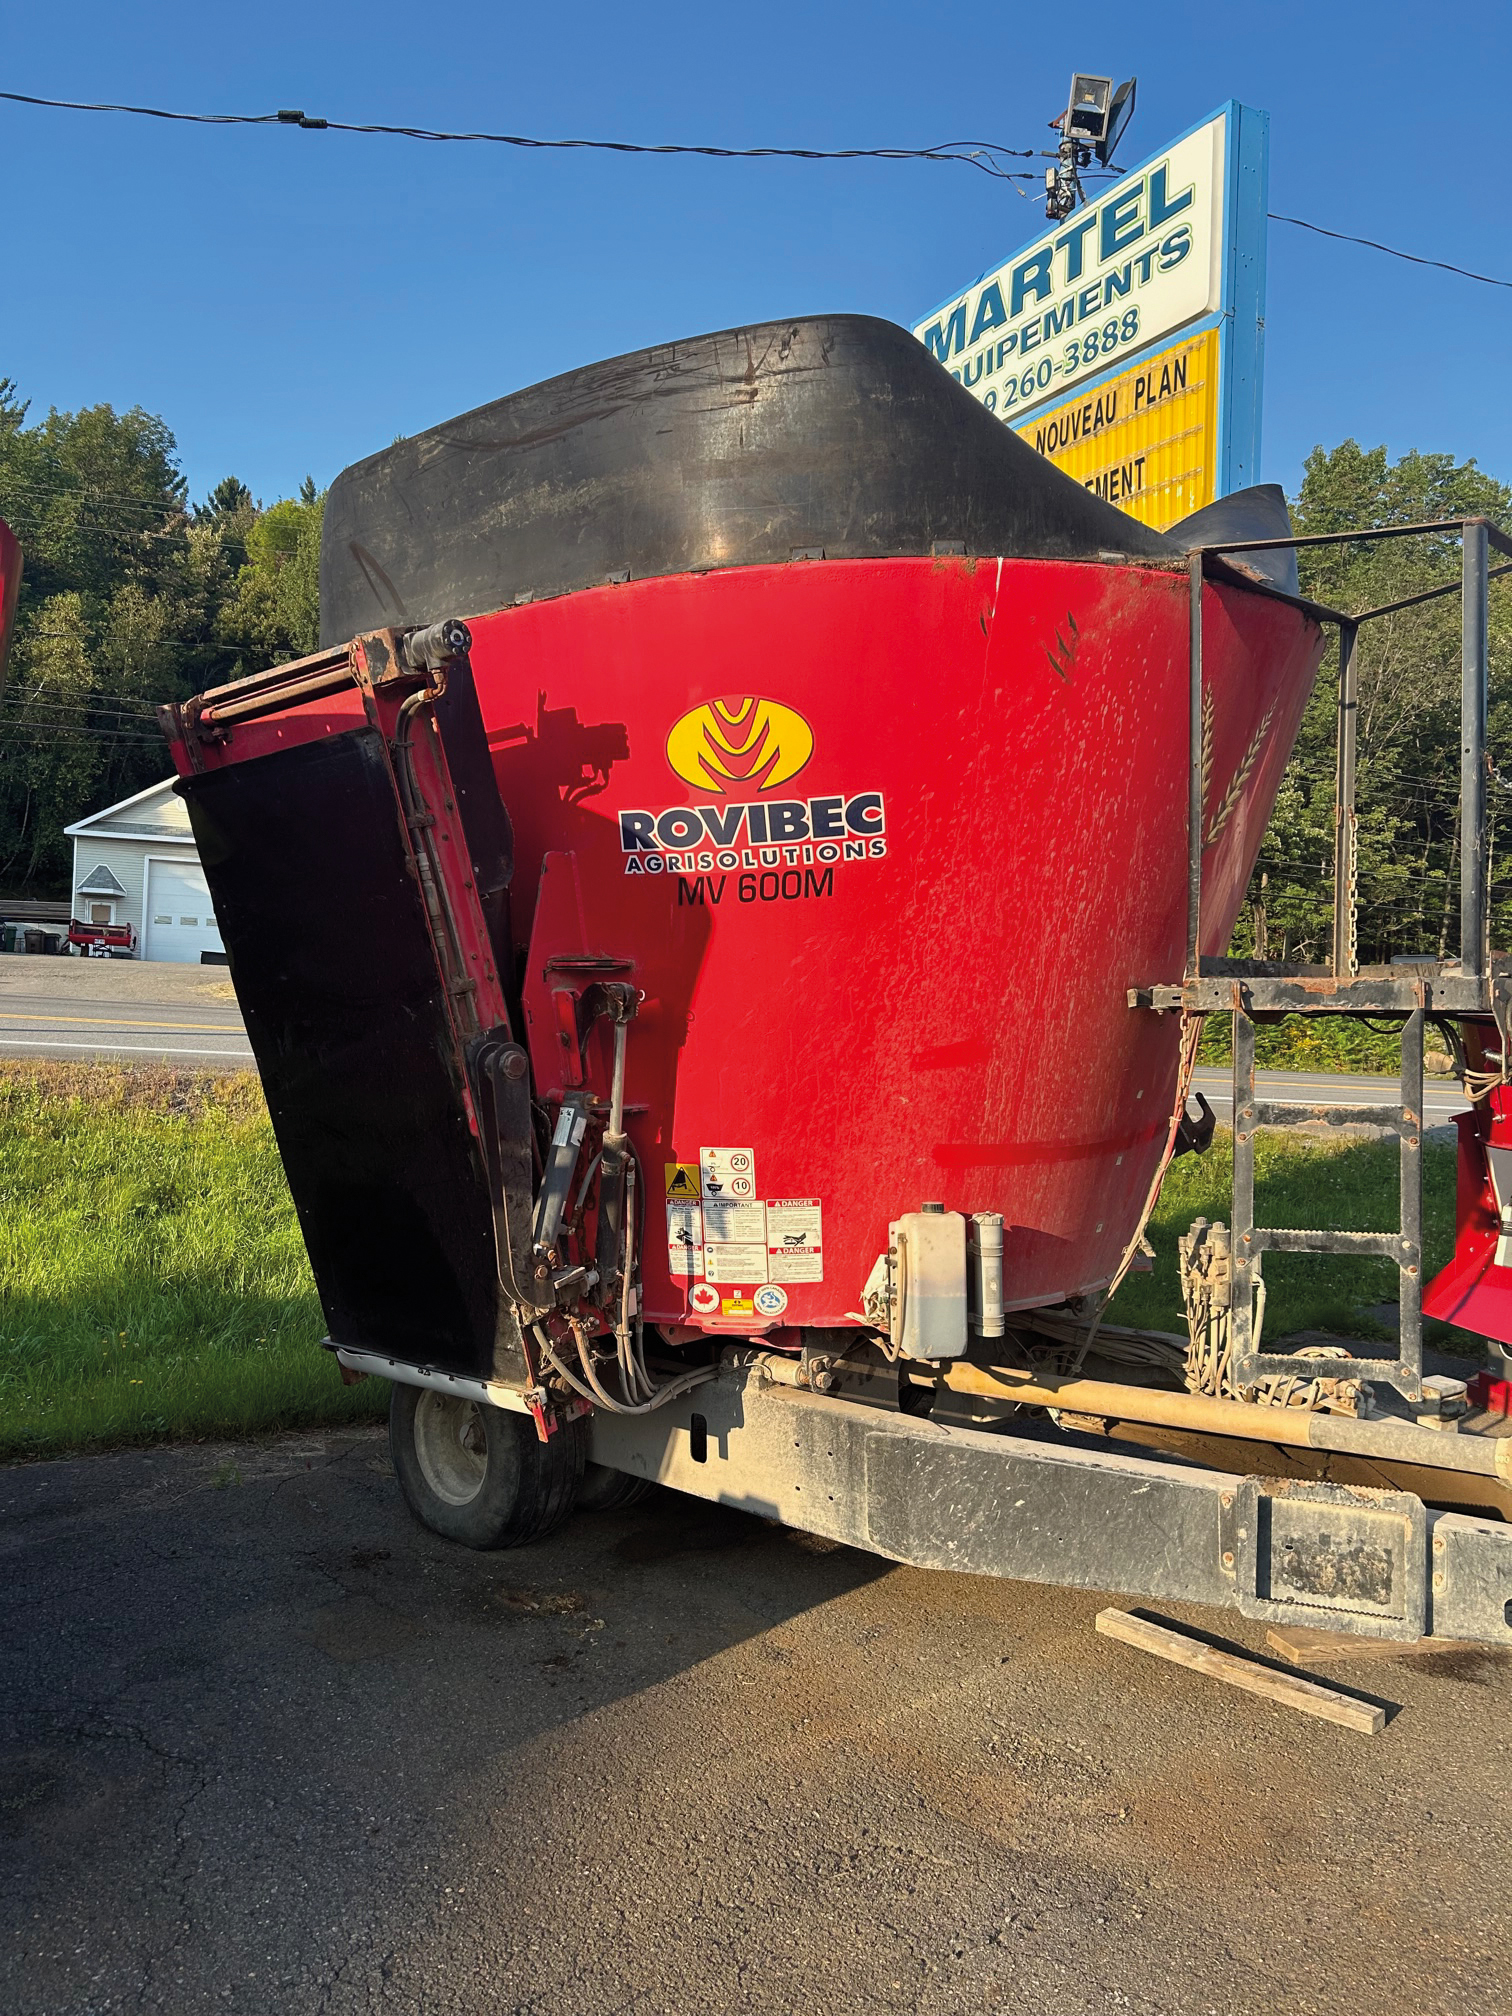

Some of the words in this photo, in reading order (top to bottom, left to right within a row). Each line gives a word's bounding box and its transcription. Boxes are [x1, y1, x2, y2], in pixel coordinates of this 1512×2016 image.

[924, 162, 1194, 364] MARTEL
[1004, 306, 1139, 409] 260-3888
[1036, 391, 1117, 455] NOUVEAU
[1134, 354, 1187, 411] PLAN
[618, 792, 887, 853] ROVIBEC
[624, 838, 888, 875] AGRISOLUTIONS
[678, 874, 727, 906] MV
[738, 867, 834, 904] 600M
[733, 1157, 746, 1166] 20
[735, 1181, 747, 1190] 10
